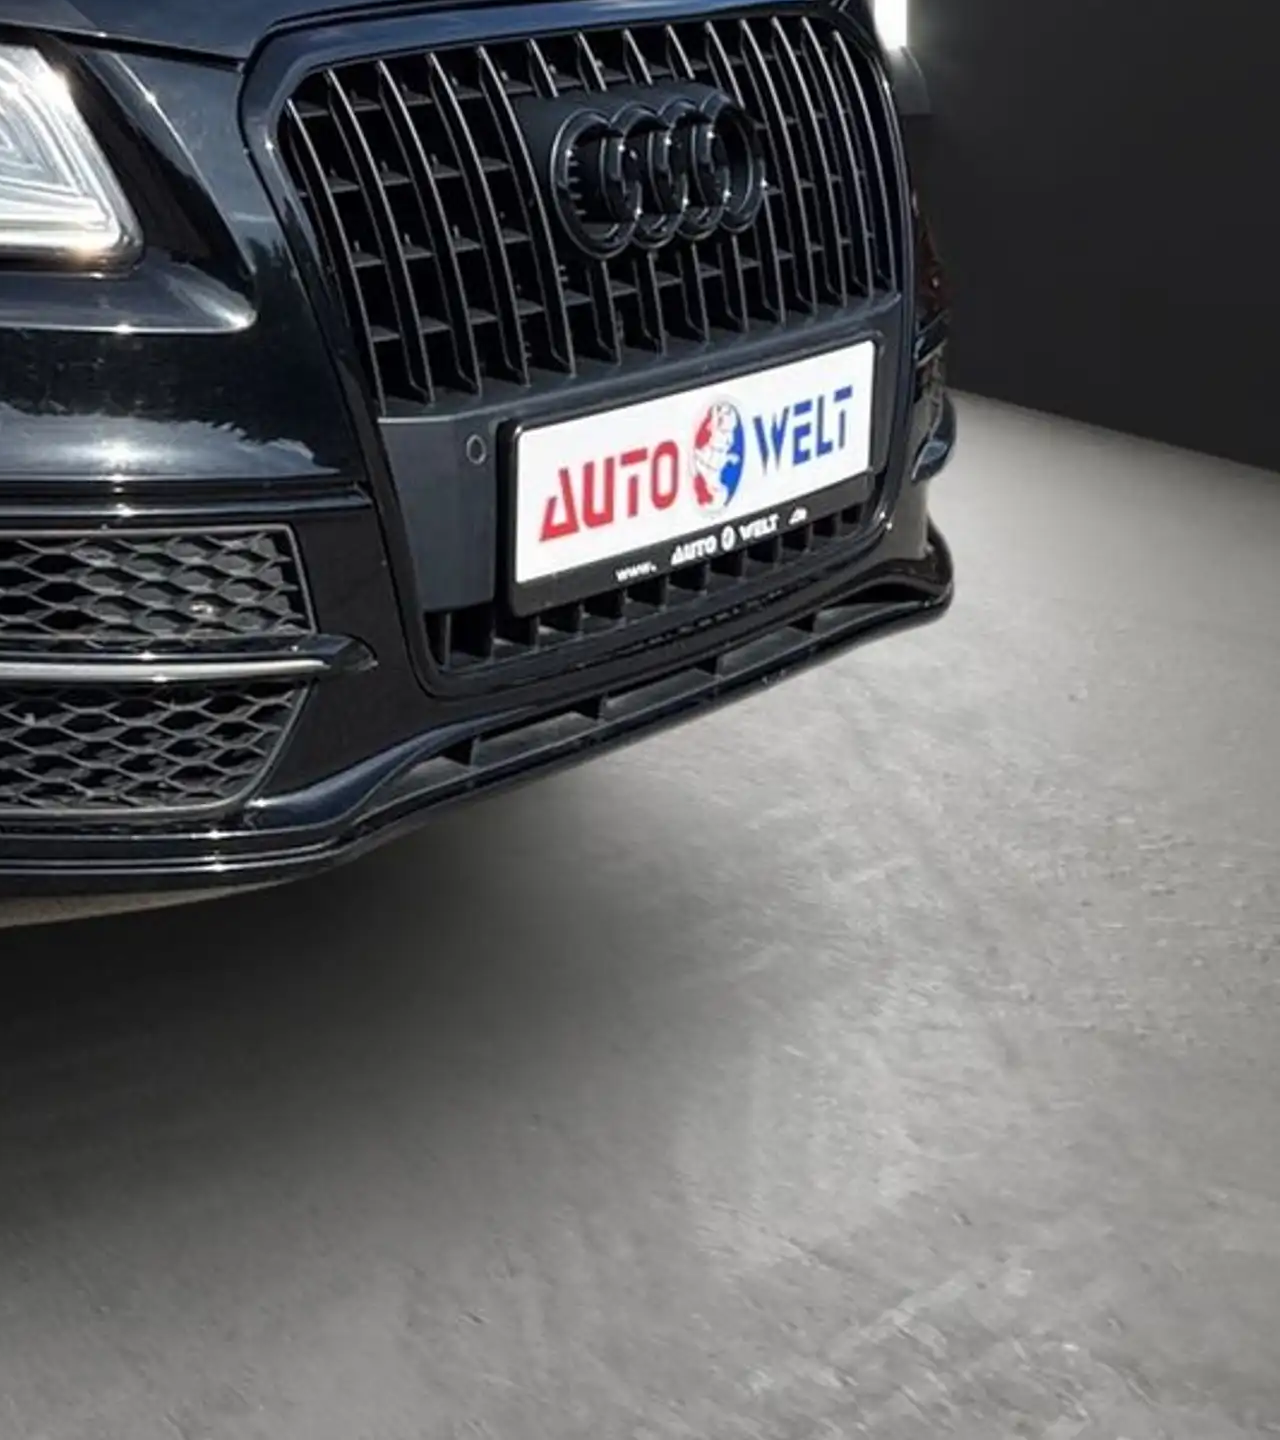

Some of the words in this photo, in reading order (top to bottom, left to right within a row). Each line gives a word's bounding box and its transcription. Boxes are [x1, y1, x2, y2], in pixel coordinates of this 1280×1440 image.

[539, 439, 680, 543] AUTO
[752, 385, 853, 476] WELT
[671, 535, 717, 566] AUTO
[739, 514, 779, 541] WELT
